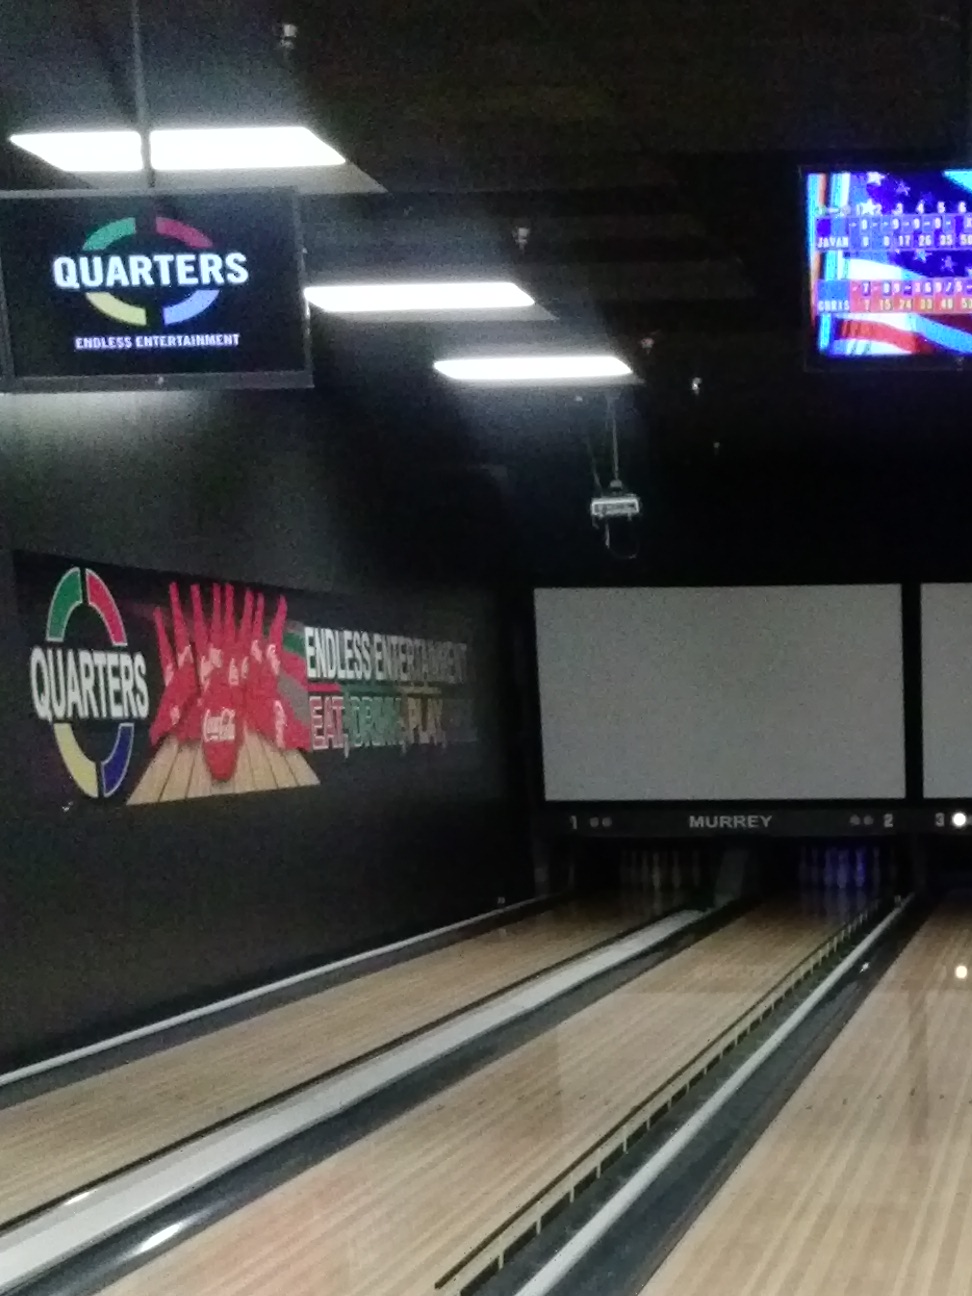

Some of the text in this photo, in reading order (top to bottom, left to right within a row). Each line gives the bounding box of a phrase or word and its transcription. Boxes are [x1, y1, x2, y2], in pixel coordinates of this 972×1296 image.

[53, 252, 249, 290] QUARTERS
[75, 333, 240, 350] ENDLESS ENTERTAINMENT
[304, 626, 373, 681] ENDLESS
[30, 646, 150, 721] QUARTERS
[688, 814, 773, 829] MURREY
[883, 813, 894, 828] 2
[934, 812, 945, 827] 3
